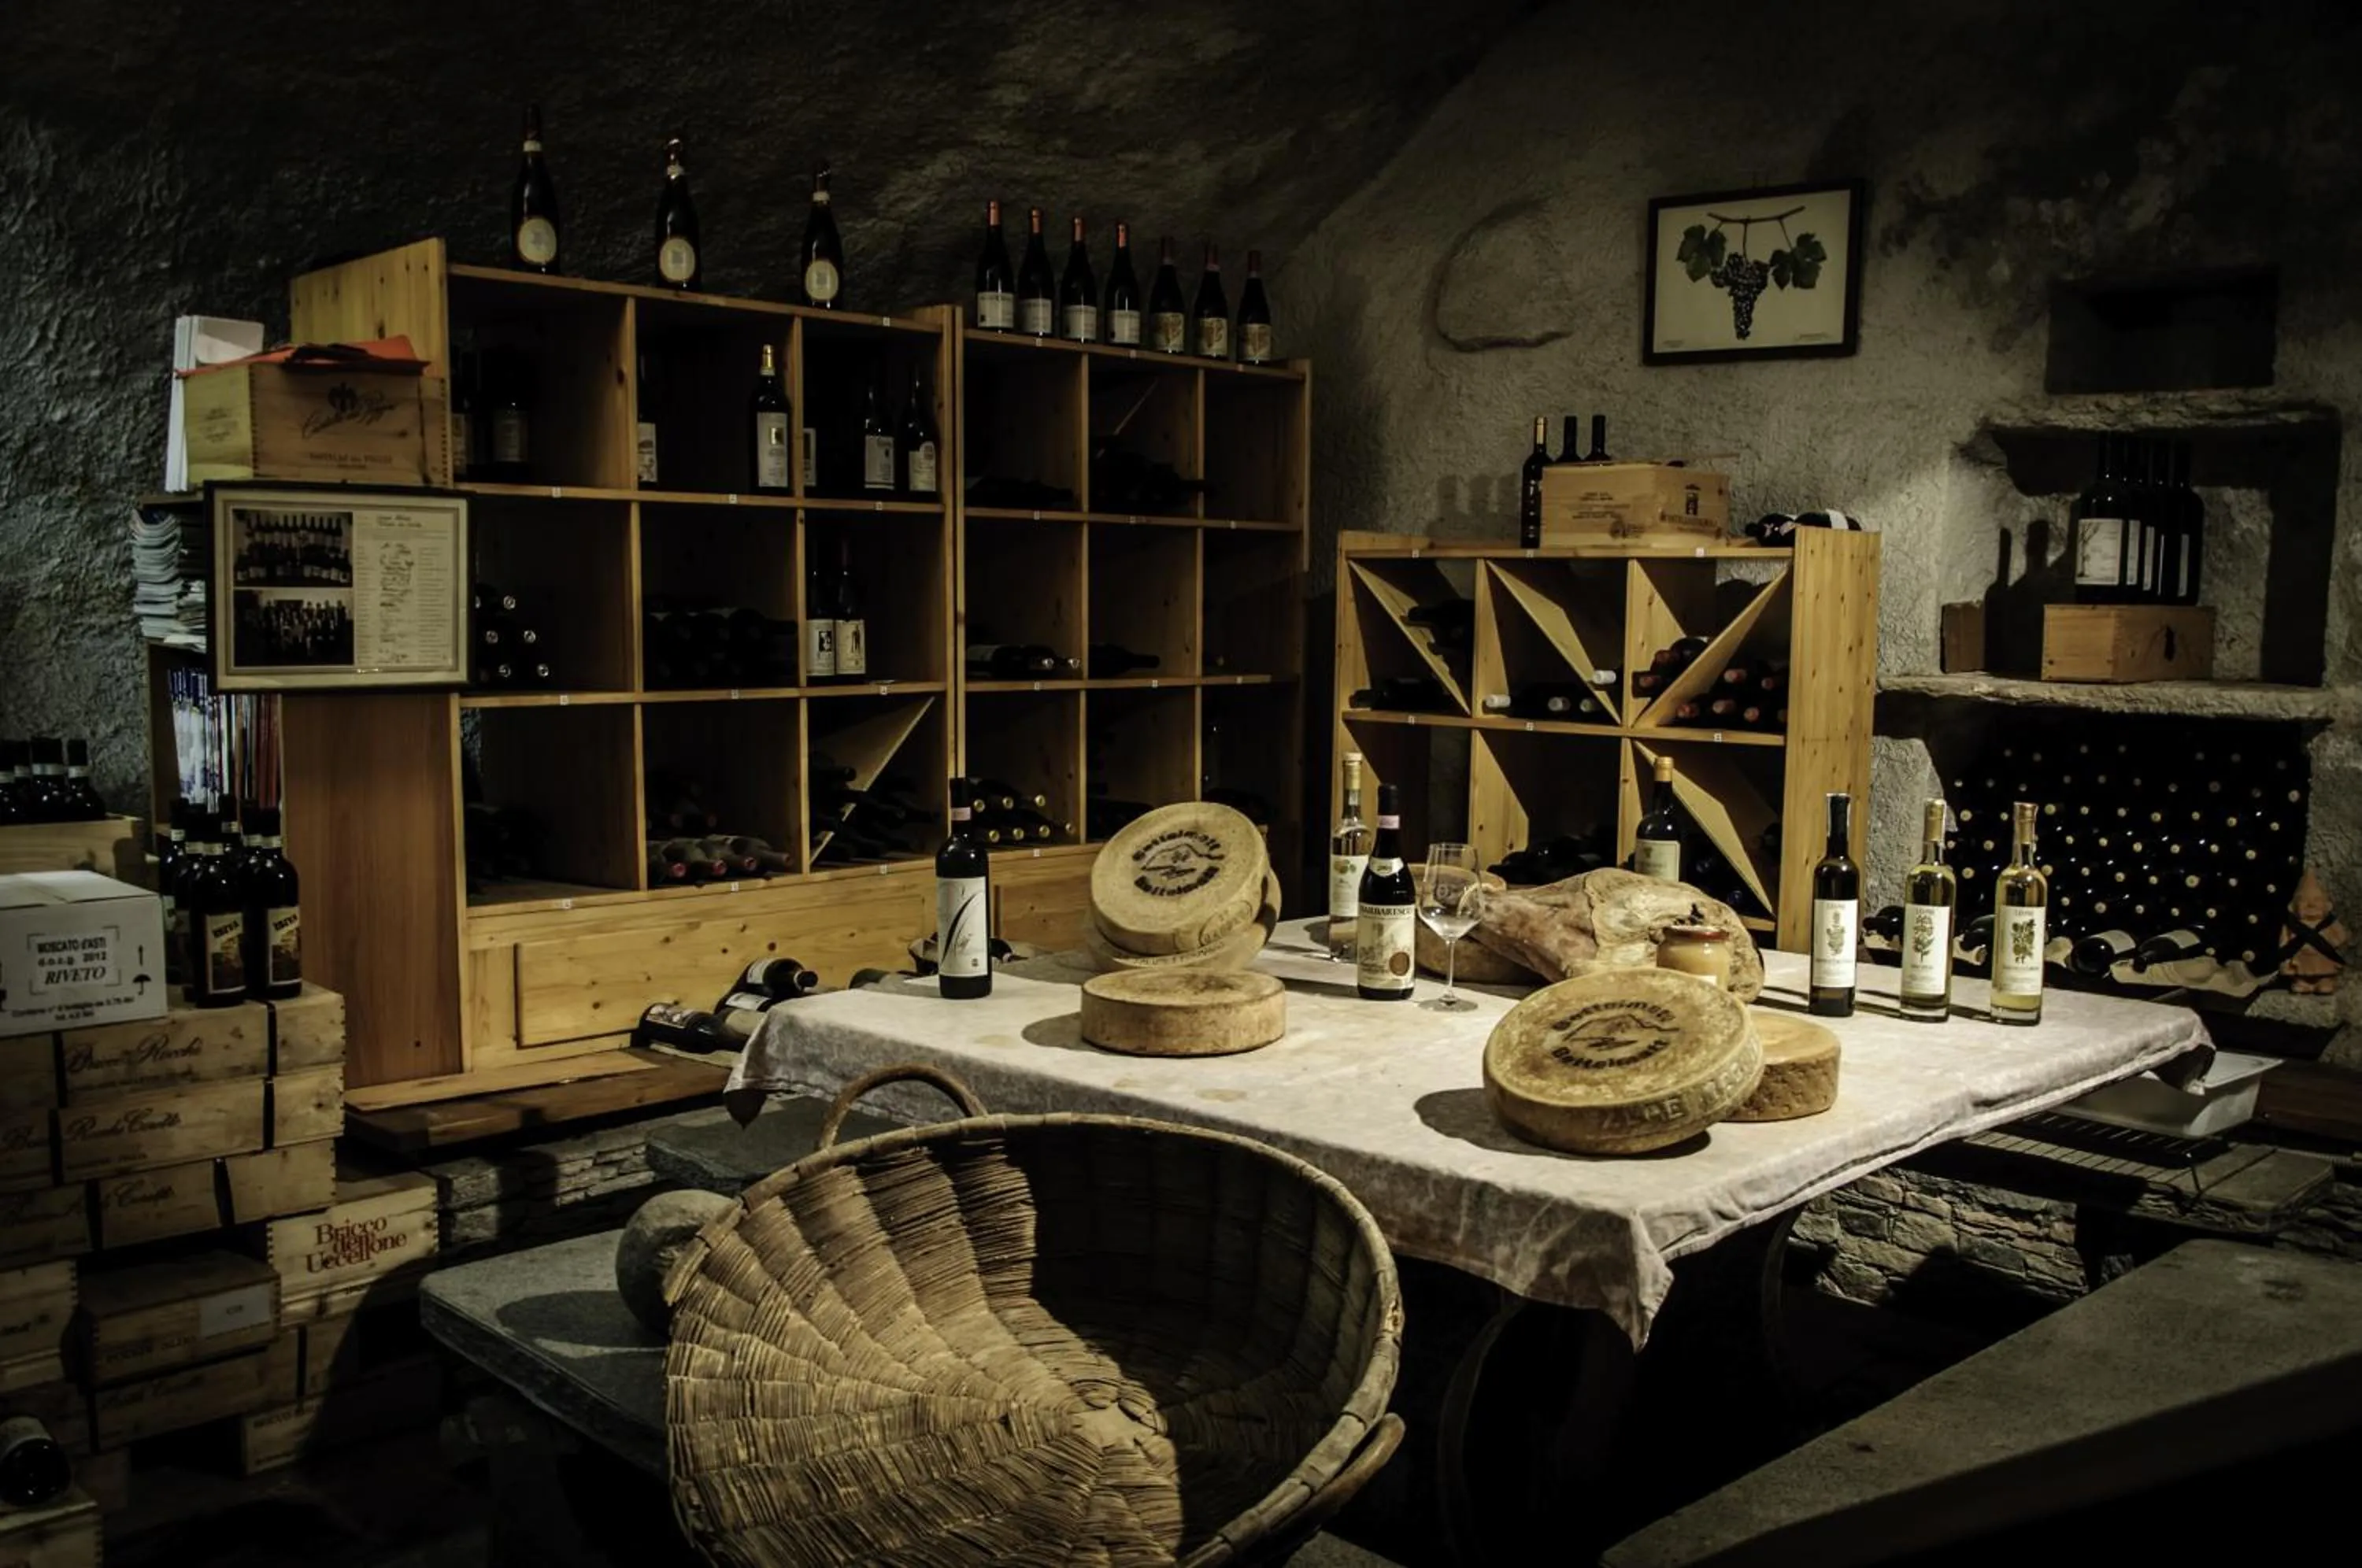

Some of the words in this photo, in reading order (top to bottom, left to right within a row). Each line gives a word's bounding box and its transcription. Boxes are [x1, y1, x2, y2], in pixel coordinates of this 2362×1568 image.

[38, 941, 80, 954] MOSCATO
[83, 952, 107, 963] 2012
[44, 966, 106, 985] RIVETO
[315, 1217, 388, 1245] Bricco
